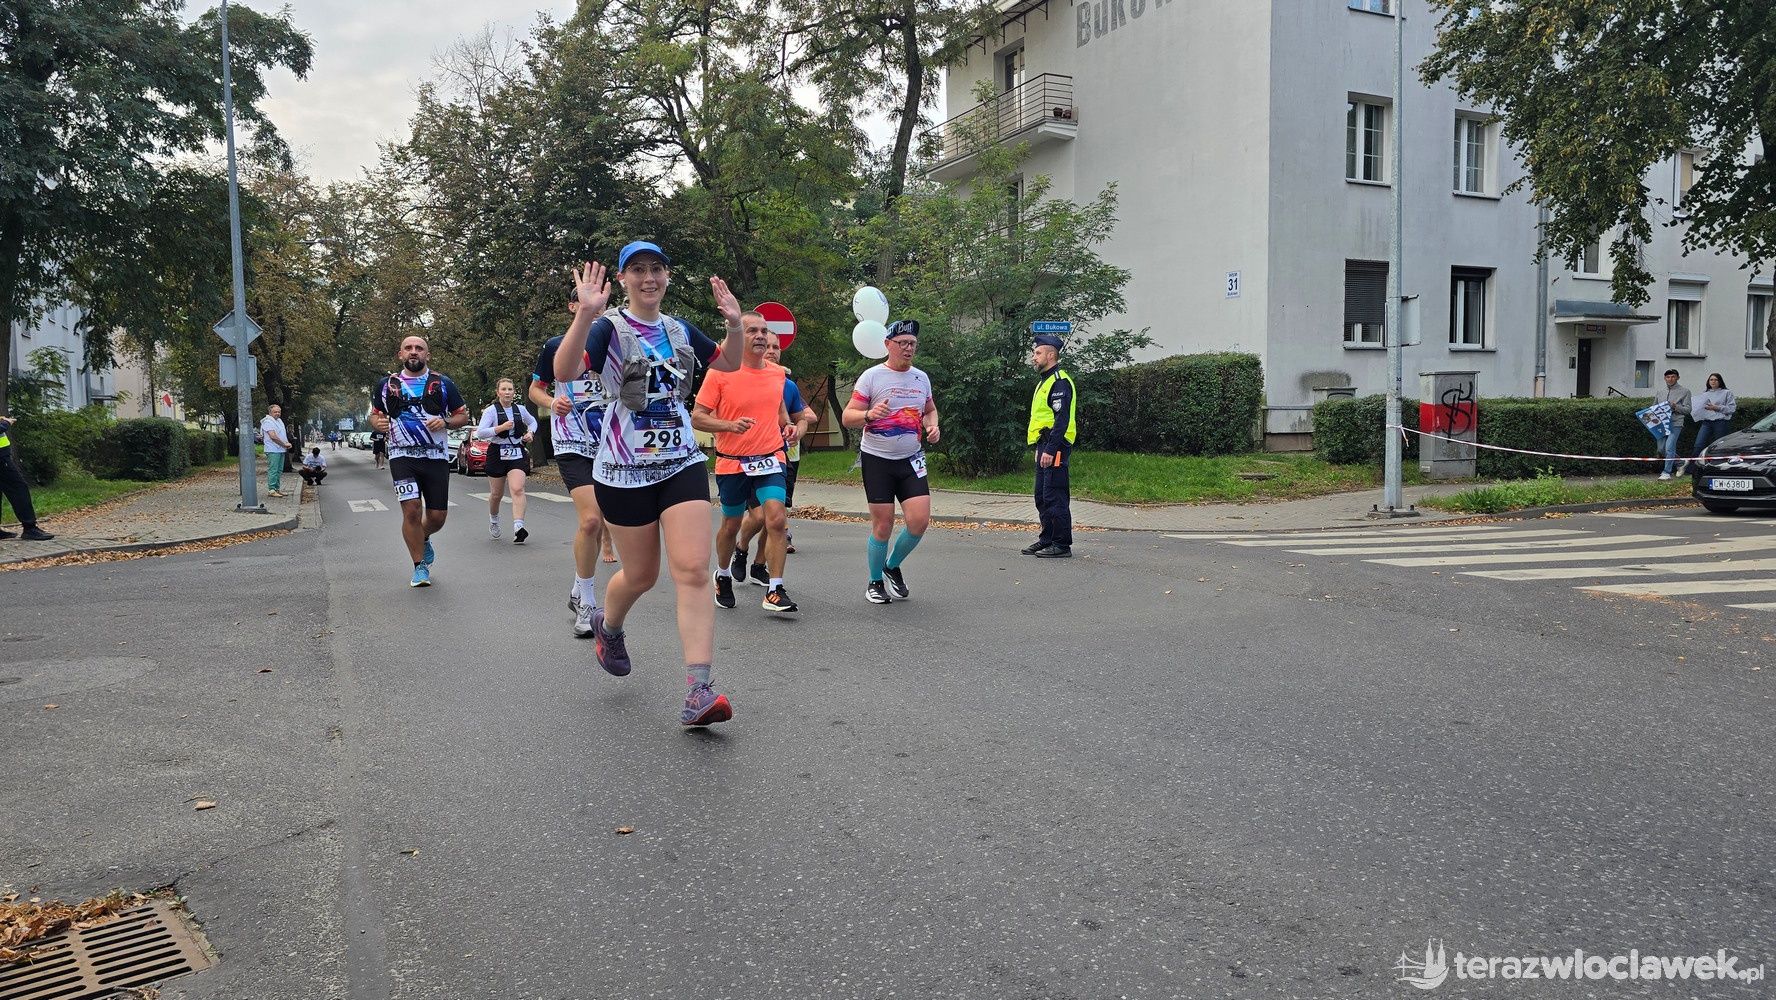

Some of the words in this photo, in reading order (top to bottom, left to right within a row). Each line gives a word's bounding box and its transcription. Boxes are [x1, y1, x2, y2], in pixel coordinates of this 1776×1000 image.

[1077, 0, 1173, 48] Buko
[1228, 277, 1238, 291] 31
[643, 429, 681, 448] 298
[748, 459, 773, 471] 640
[1713, 480, 1724, 488] CW
